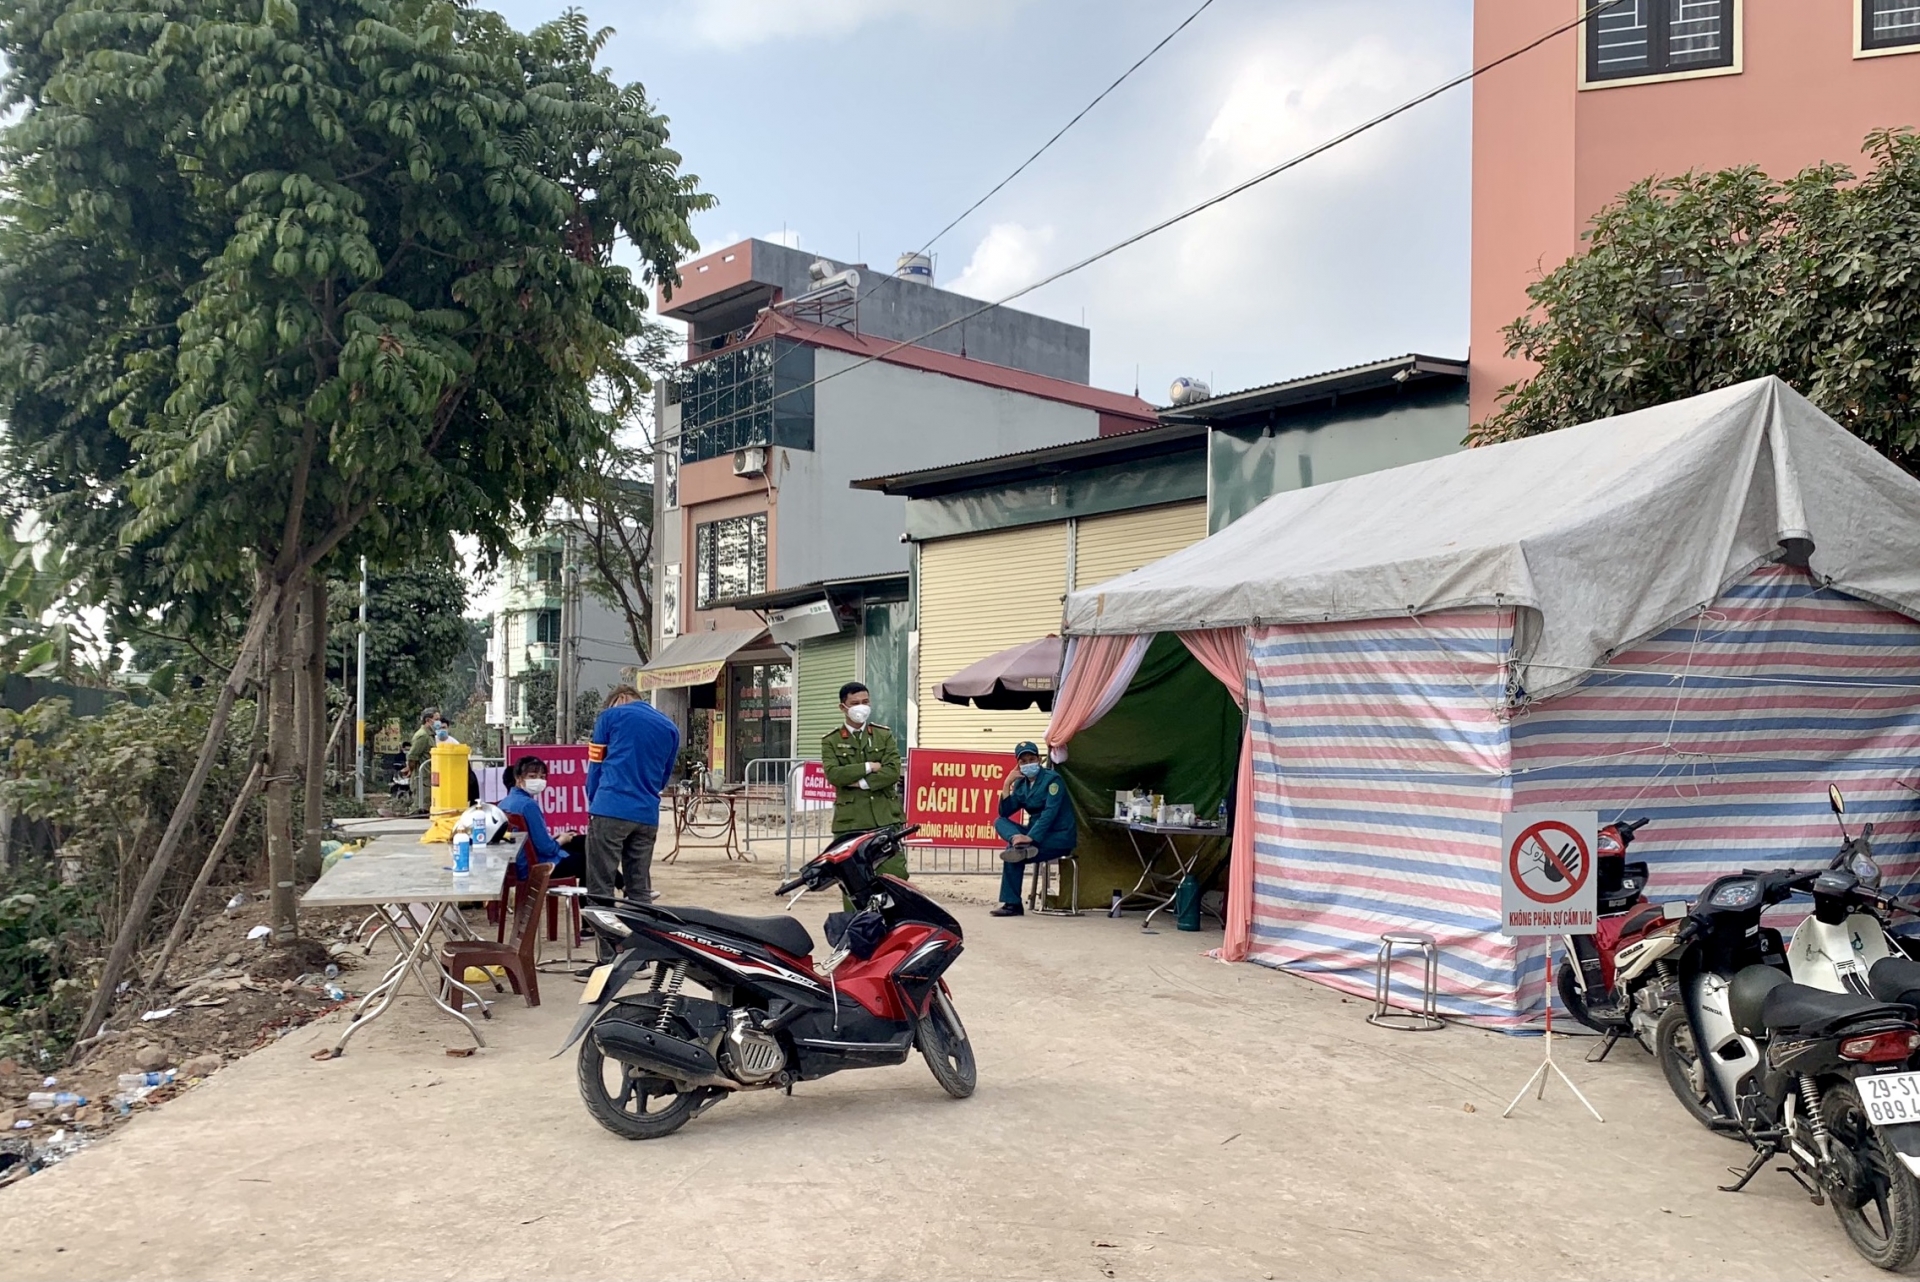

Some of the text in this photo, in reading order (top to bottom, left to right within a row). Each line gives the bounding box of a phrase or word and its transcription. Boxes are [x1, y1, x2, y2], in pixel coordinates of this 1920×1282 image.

[804, 775, 824, 788] CÁCH
[932, 762, 1003, 781] KHU VỰC
[916, 782, 957, 813] CÁCH
[961, 788, 980, 813] LY
[983, 789, 993, 814] Y
[916, 820, 996, 842] KHÔNG PHẬN SỰ MIỄN
[1509, 907, 1593, 929] KHÔNG PHẬN SỰ CẤM VÀO
[668, 931, 743, 956] AIR BLADE
[1702, 1004, 1723, 1016] HONDA
[1867, 1076, 1920, 1099] 29-S1
